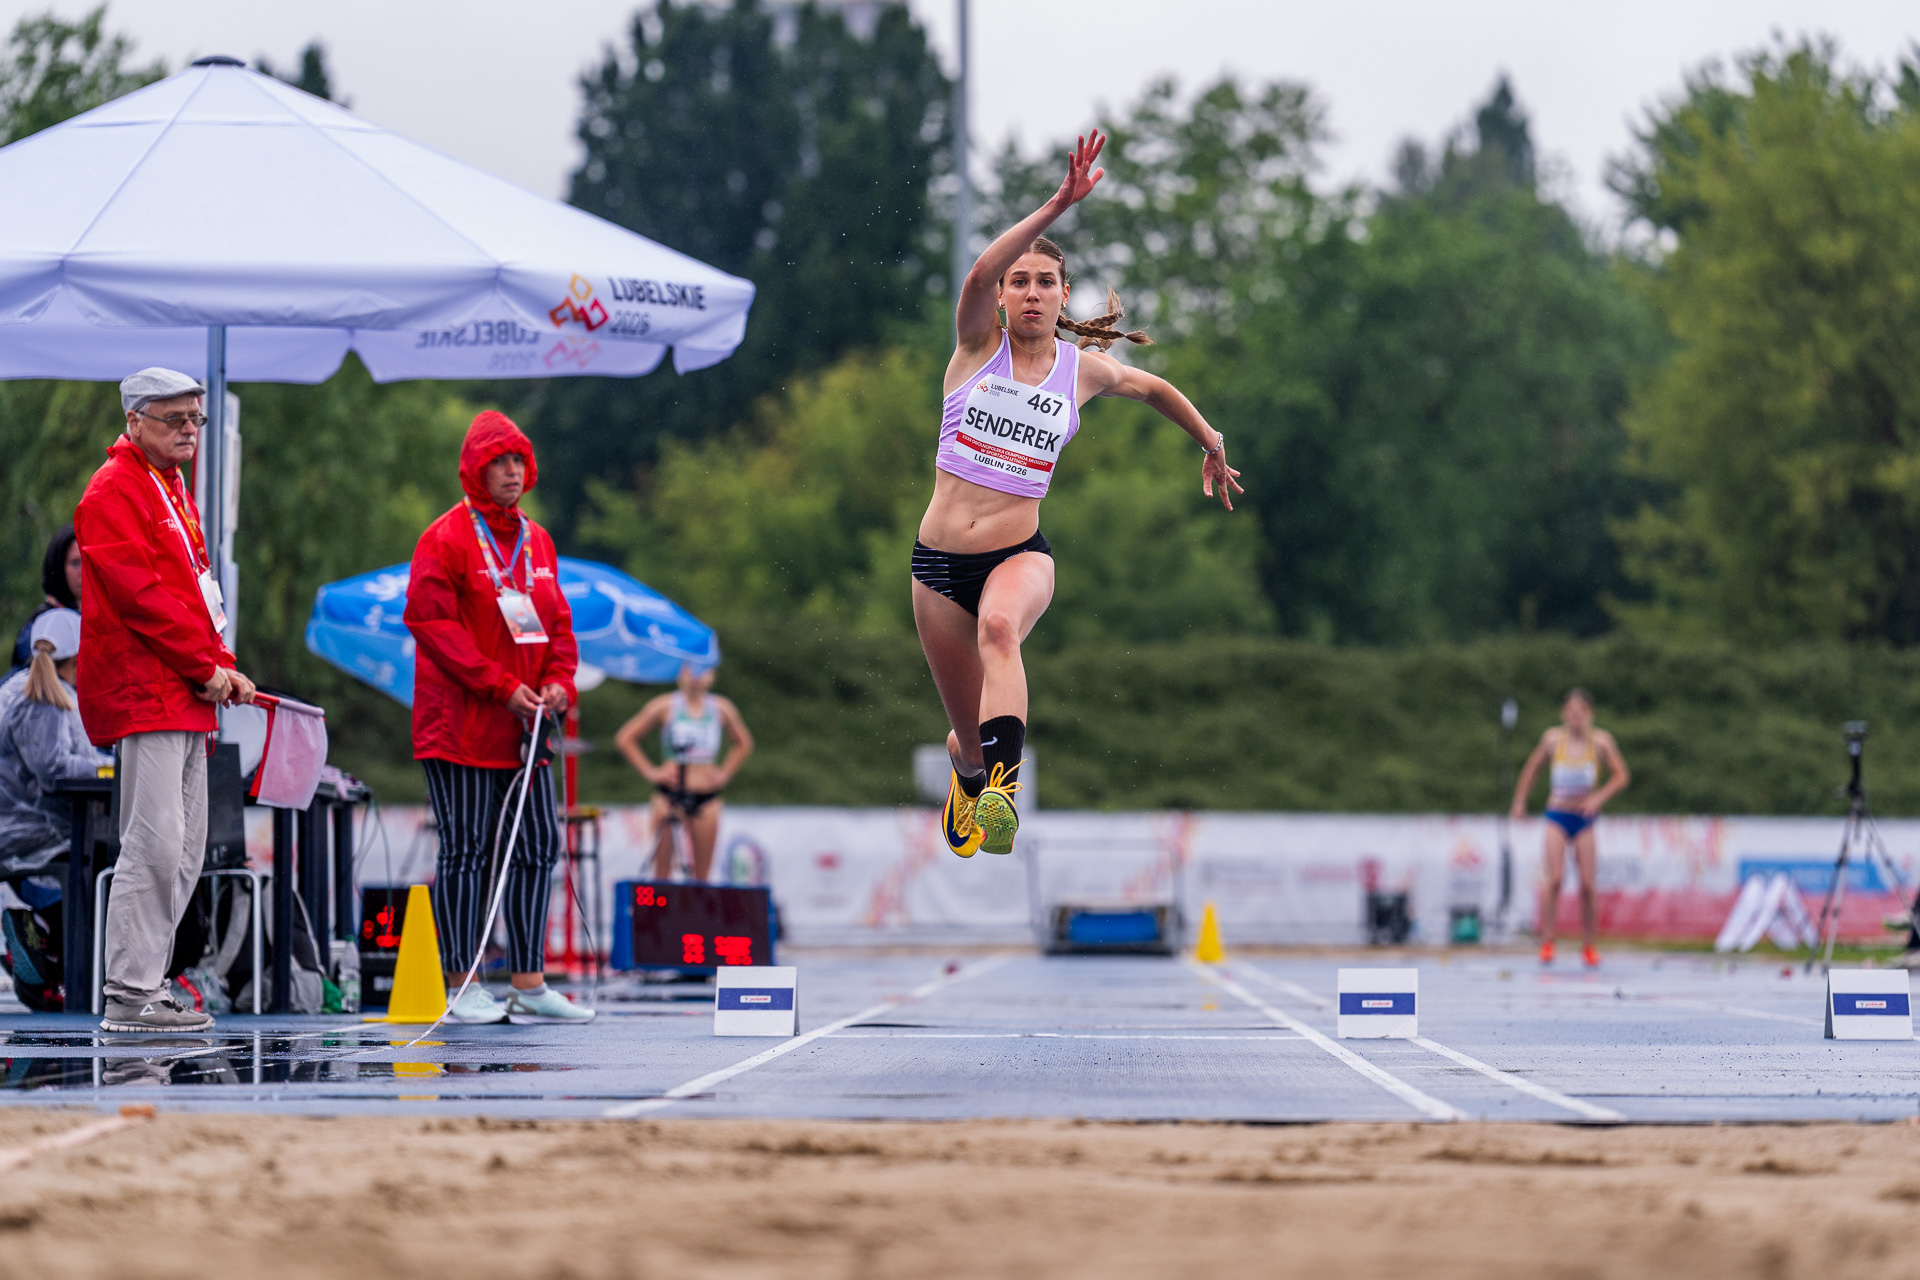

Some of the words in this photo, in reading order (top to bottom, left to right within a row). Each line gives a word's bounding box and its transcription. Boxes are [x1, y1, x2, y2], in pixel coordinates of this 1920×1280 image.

[607, 277, 706, 311] LUBELSKIE
[991, 383, 1019, 396] LUBELSKIE
[1027, 393, 1063, 417] 467
[965, 406, 1061, 453] SENDEREK
[974, 453, 1004, 469] LUBLIN
[1006, 463, 1028, 476] 2026
